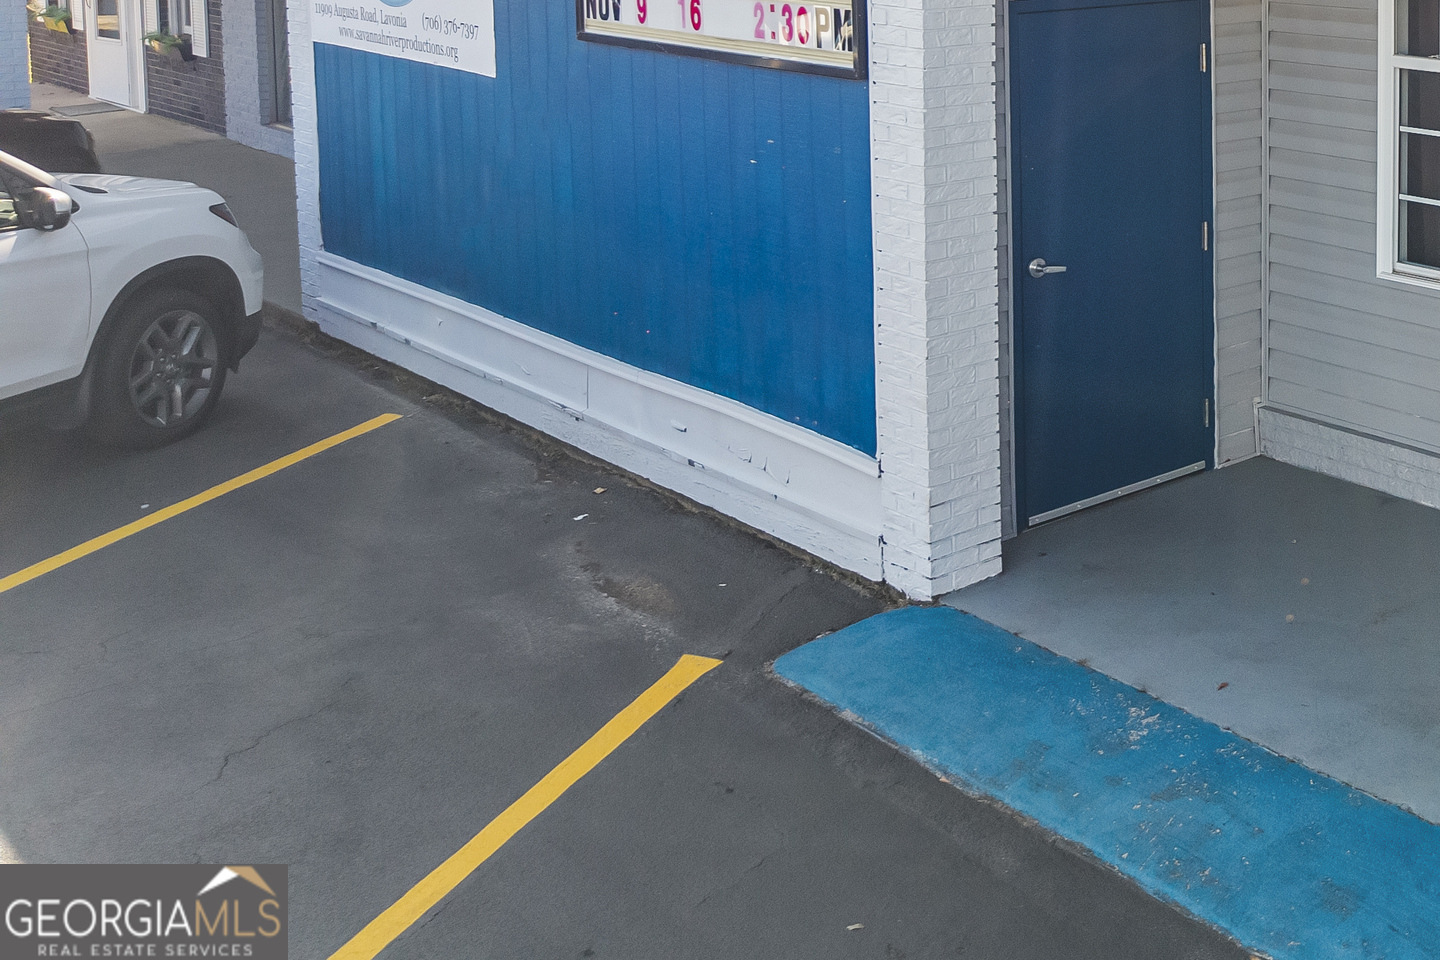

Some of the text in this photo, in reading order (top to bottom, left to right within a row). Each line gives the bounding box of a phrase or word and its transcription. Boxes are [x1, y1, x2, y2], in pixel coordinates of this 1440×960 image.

[315, 3, 407, 28] 11909 Augusta Road, Lavonia
[422, 12, 479, 40] (706) 376-7397
[338, 26, 459, 63] www.savannahriverproductions.org
